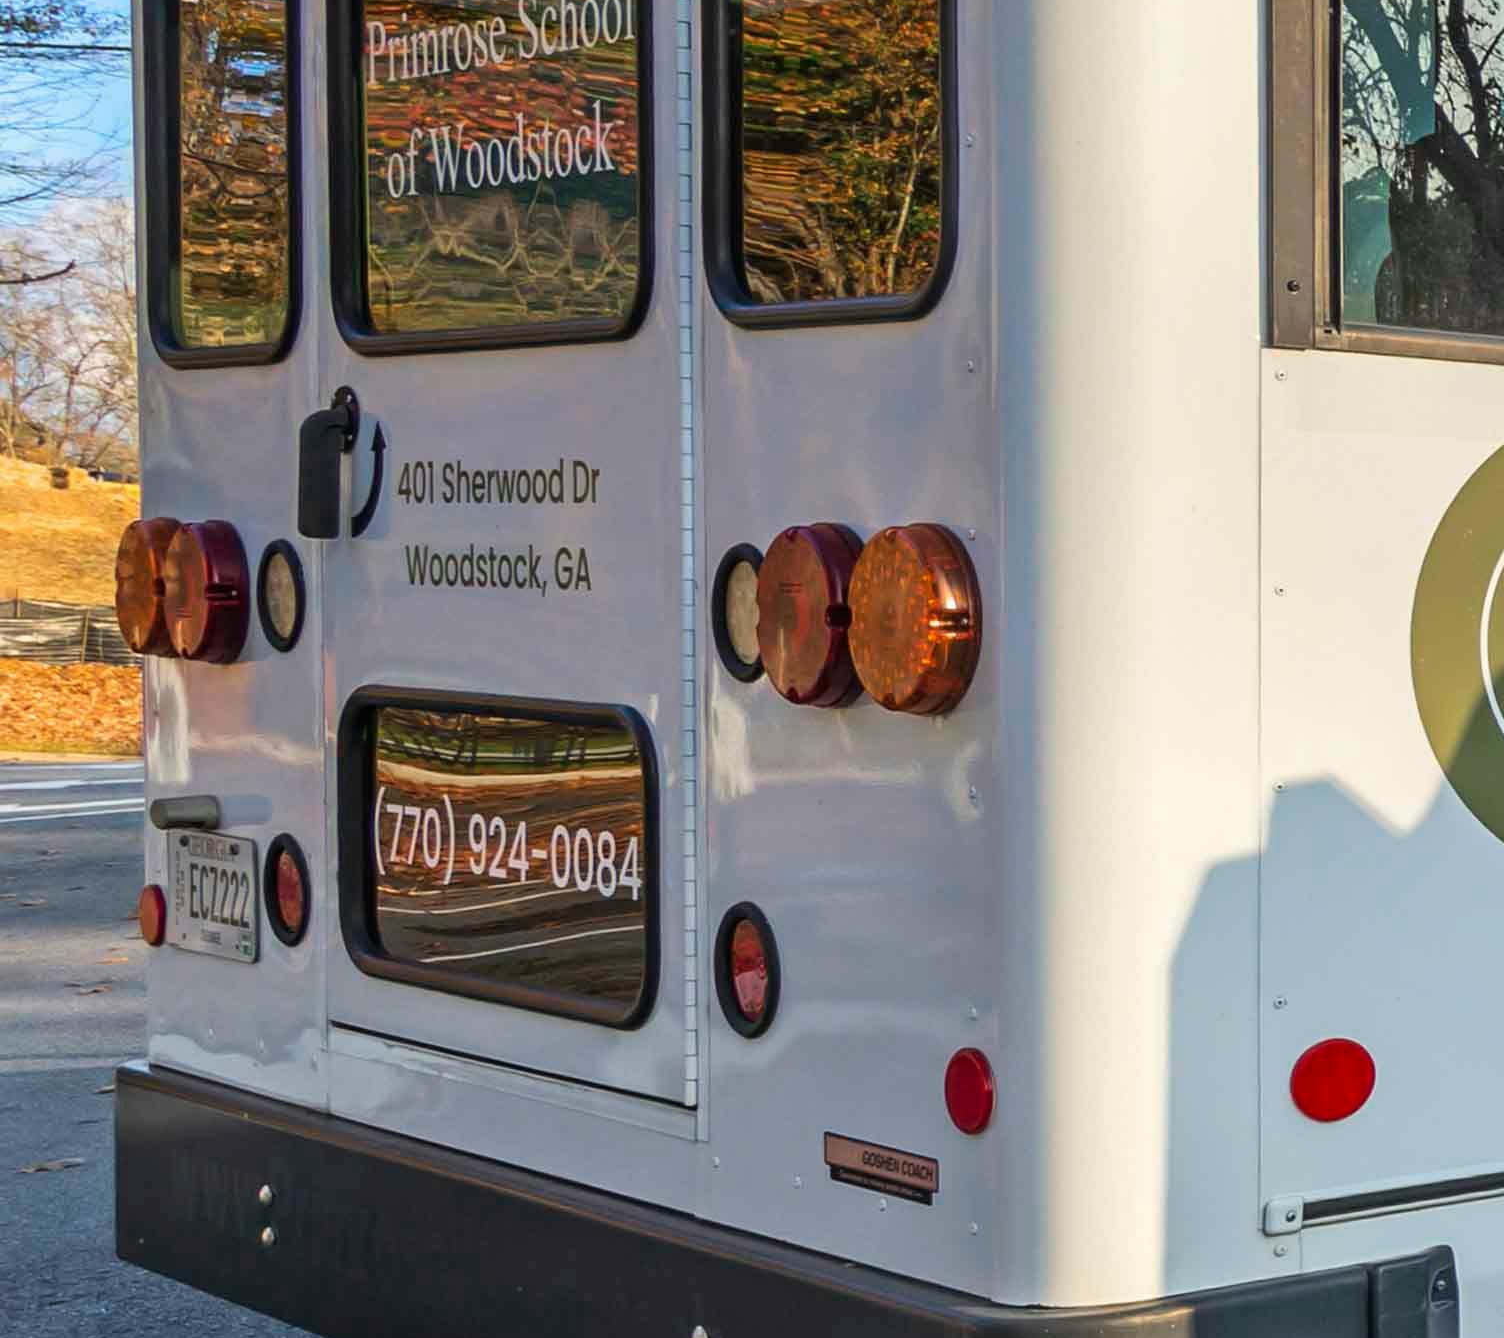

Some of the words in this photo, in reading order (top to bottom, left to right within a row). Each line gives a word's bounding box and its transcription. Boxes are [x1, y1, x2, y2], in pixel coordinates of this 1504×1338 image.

[366, 12, 507, 86] Primrose
[387, 128, 423, 198] of
[429, 99, 617, 193] Woodstock
[398, 460, 434, 505] 401
[442, 458, 565, 505] Sherwood
[572, 460, 600, 505] Dr
[405, 542, 547, 598] Woodstock,
[554, 547, 592, 591] GA
[374, 786, 455, 886] (770)
[468, 813, 642, 902] 924-0084
[189, 862, 250, 929] ECZ222
[902, 1160, 934, 1182] COACH
